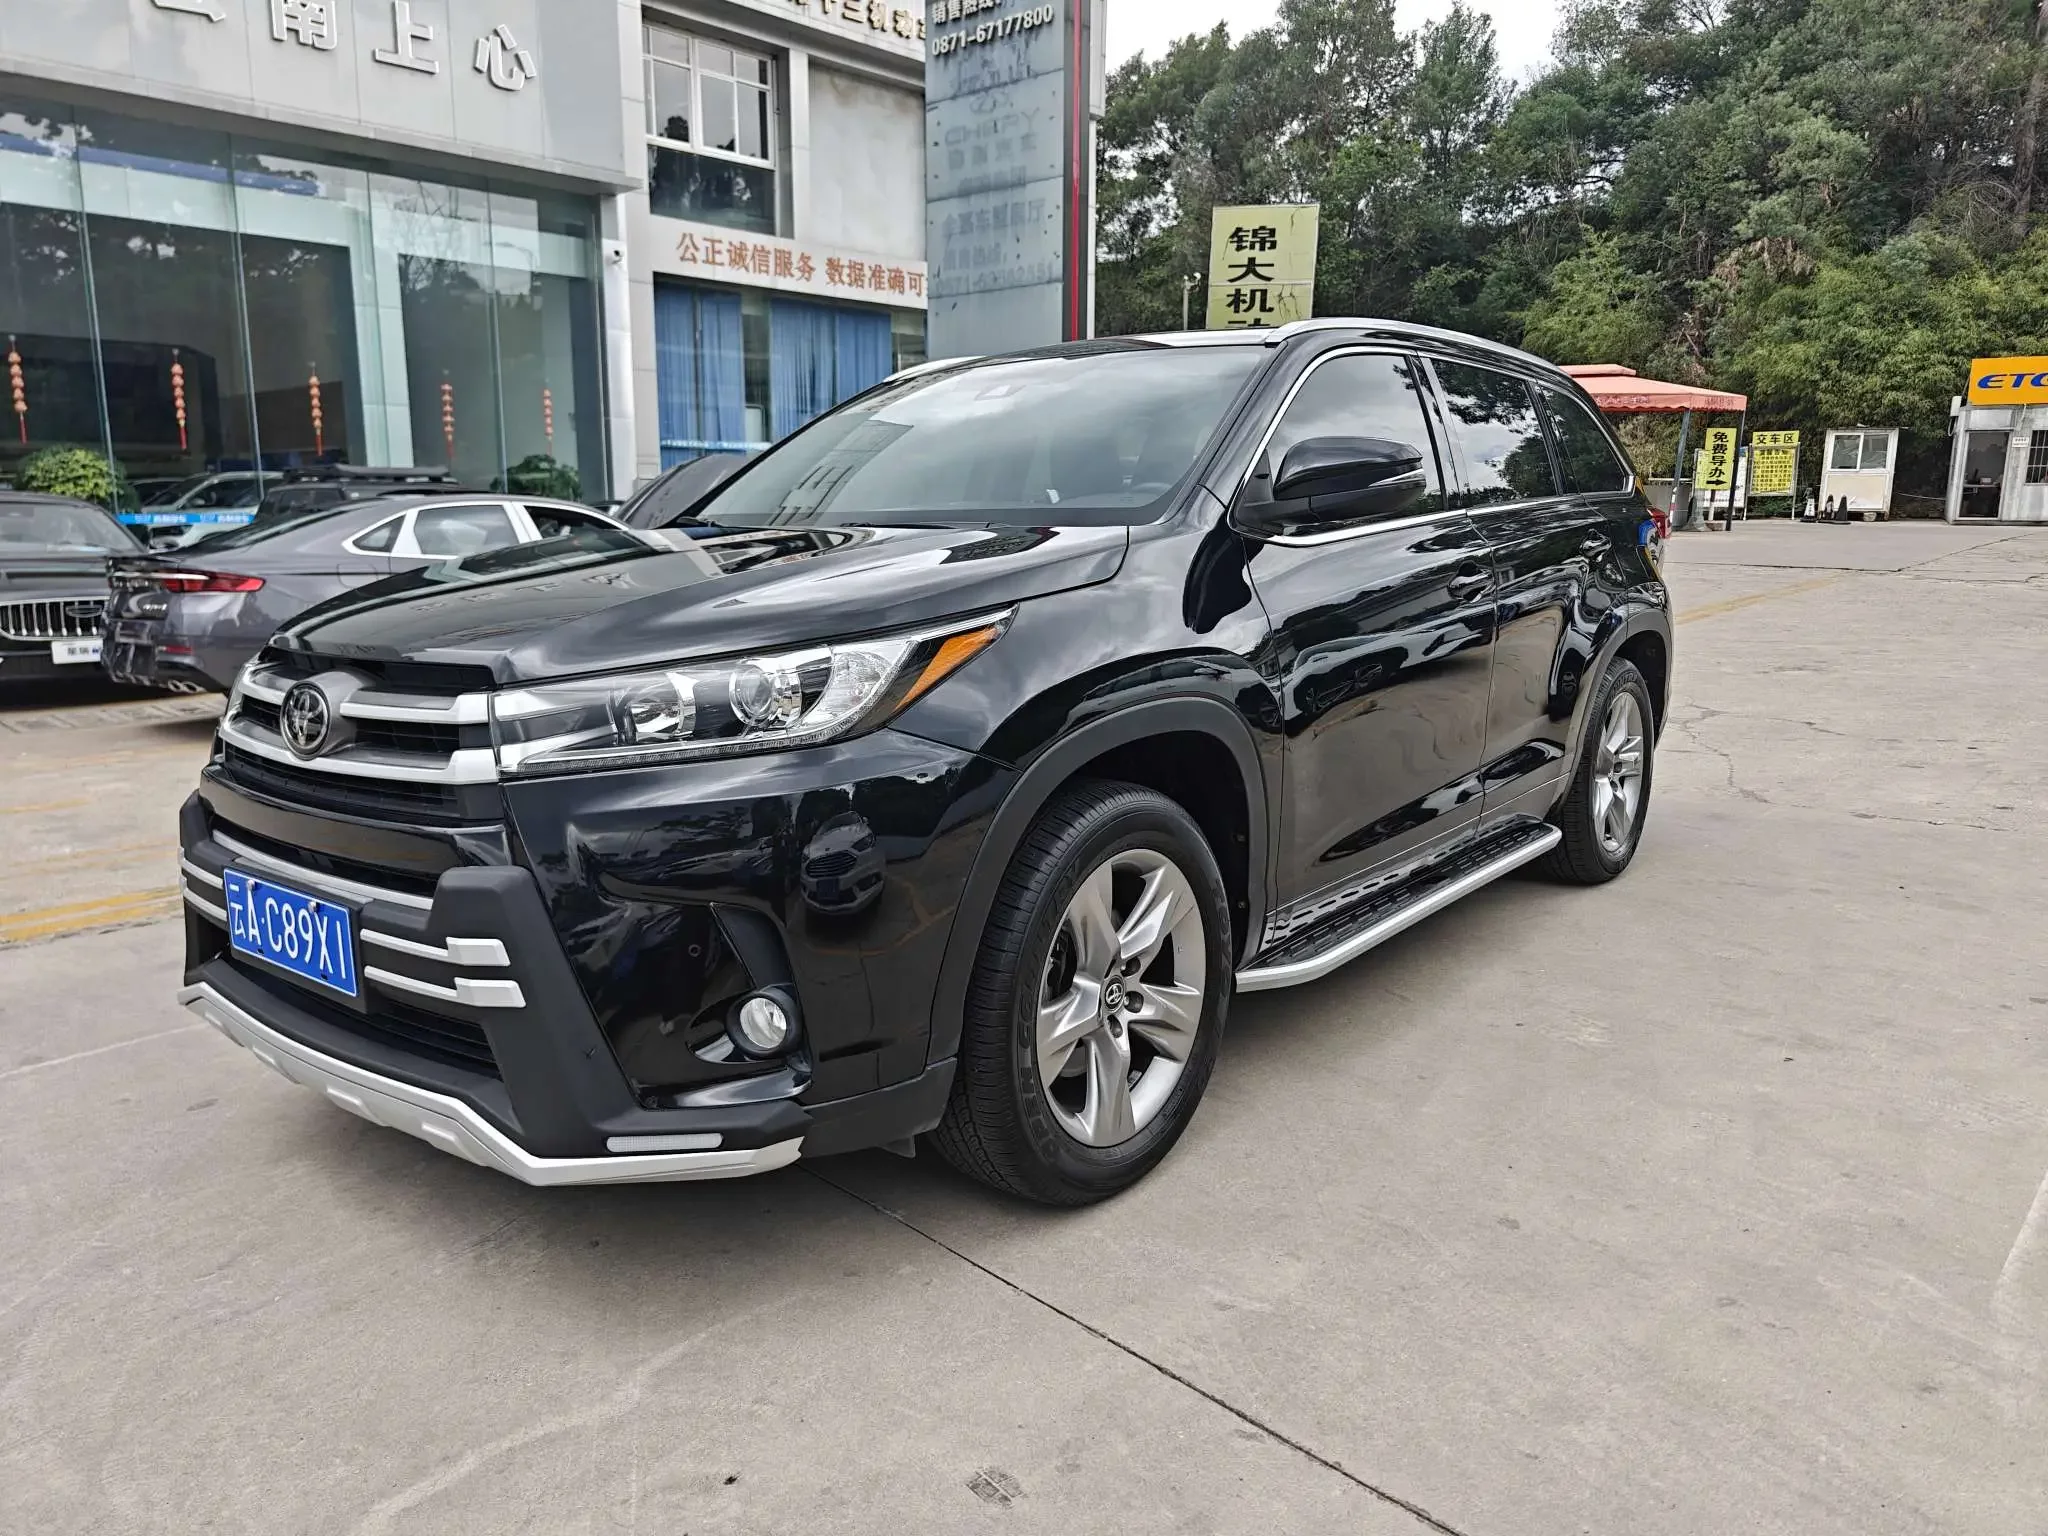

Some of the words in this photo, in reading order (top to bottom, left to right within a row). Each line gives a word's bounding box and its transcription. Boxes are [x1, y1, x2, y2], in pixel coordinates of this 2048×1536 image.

[931, 3, 1054, 56] 0871-67177800
[676, 231, 816, 283] 公正诚信服务
[824, 256, 927, 298] 数据准确可
[1709, 431, 1729, 478] 免费导办
[1756, 433, 1794, 445] 交车区
